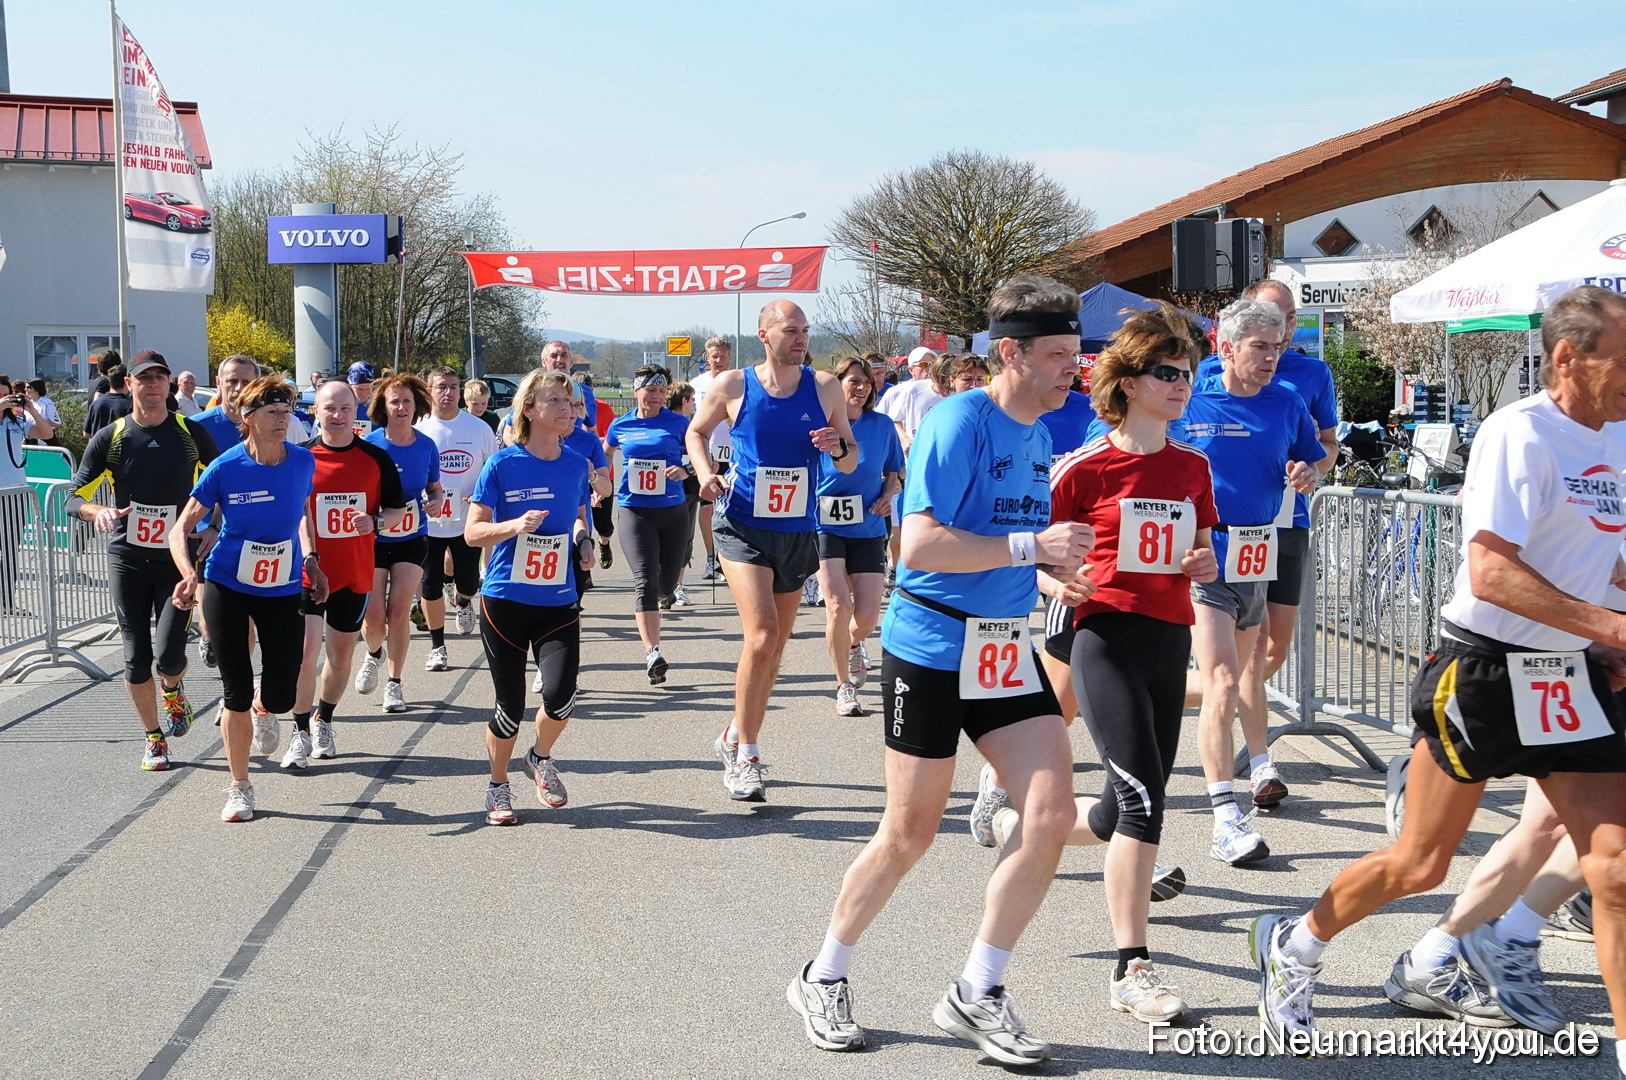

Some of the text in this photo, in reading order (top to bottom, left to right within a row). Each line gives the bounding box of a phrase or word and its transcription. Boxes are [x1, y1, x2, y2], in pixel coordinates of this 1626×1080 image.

[140, 104, 163, 116] OHRE
[140, 157, 167, 171] NEUEN
[279, 229, 370, 247] VOLVO
[717, 445, 730, 459] 70
[638, 470, 657, 490] 18
[1563, 477, 1619, 497] GERHAR
[768, 484, 797, 513] 57
[993, 497, 1019, 513] EURO
[1134, 502, 1167, 511] MEYER
[1596, 499, 1621, 515] JAN
[435, 499, 452, 518] 4
[829, 499, 854, 521] 45
[1134, 510, 1168, 518] WERBUNG
[328, 507, 356, 534] 68
[137, 517, 165, 543] 52
[1239, 529, 1263, 537] MEYER
[251, 544, 276, 552] MEYER
[526, 536, 552, 544] MEYER
[1138, 521, 1173, 565] 81
[525, 550, 558, 580] 58
[1237, 543, 1267, 576] 69
[253, 558, 279, 584] 61
[978, 622, 1009, 631] MEYER
[978, 643, 1024, 689] 82
[1523, 657, 1562, 668] MEYER
[1530, 680, 1581, 732] 73
